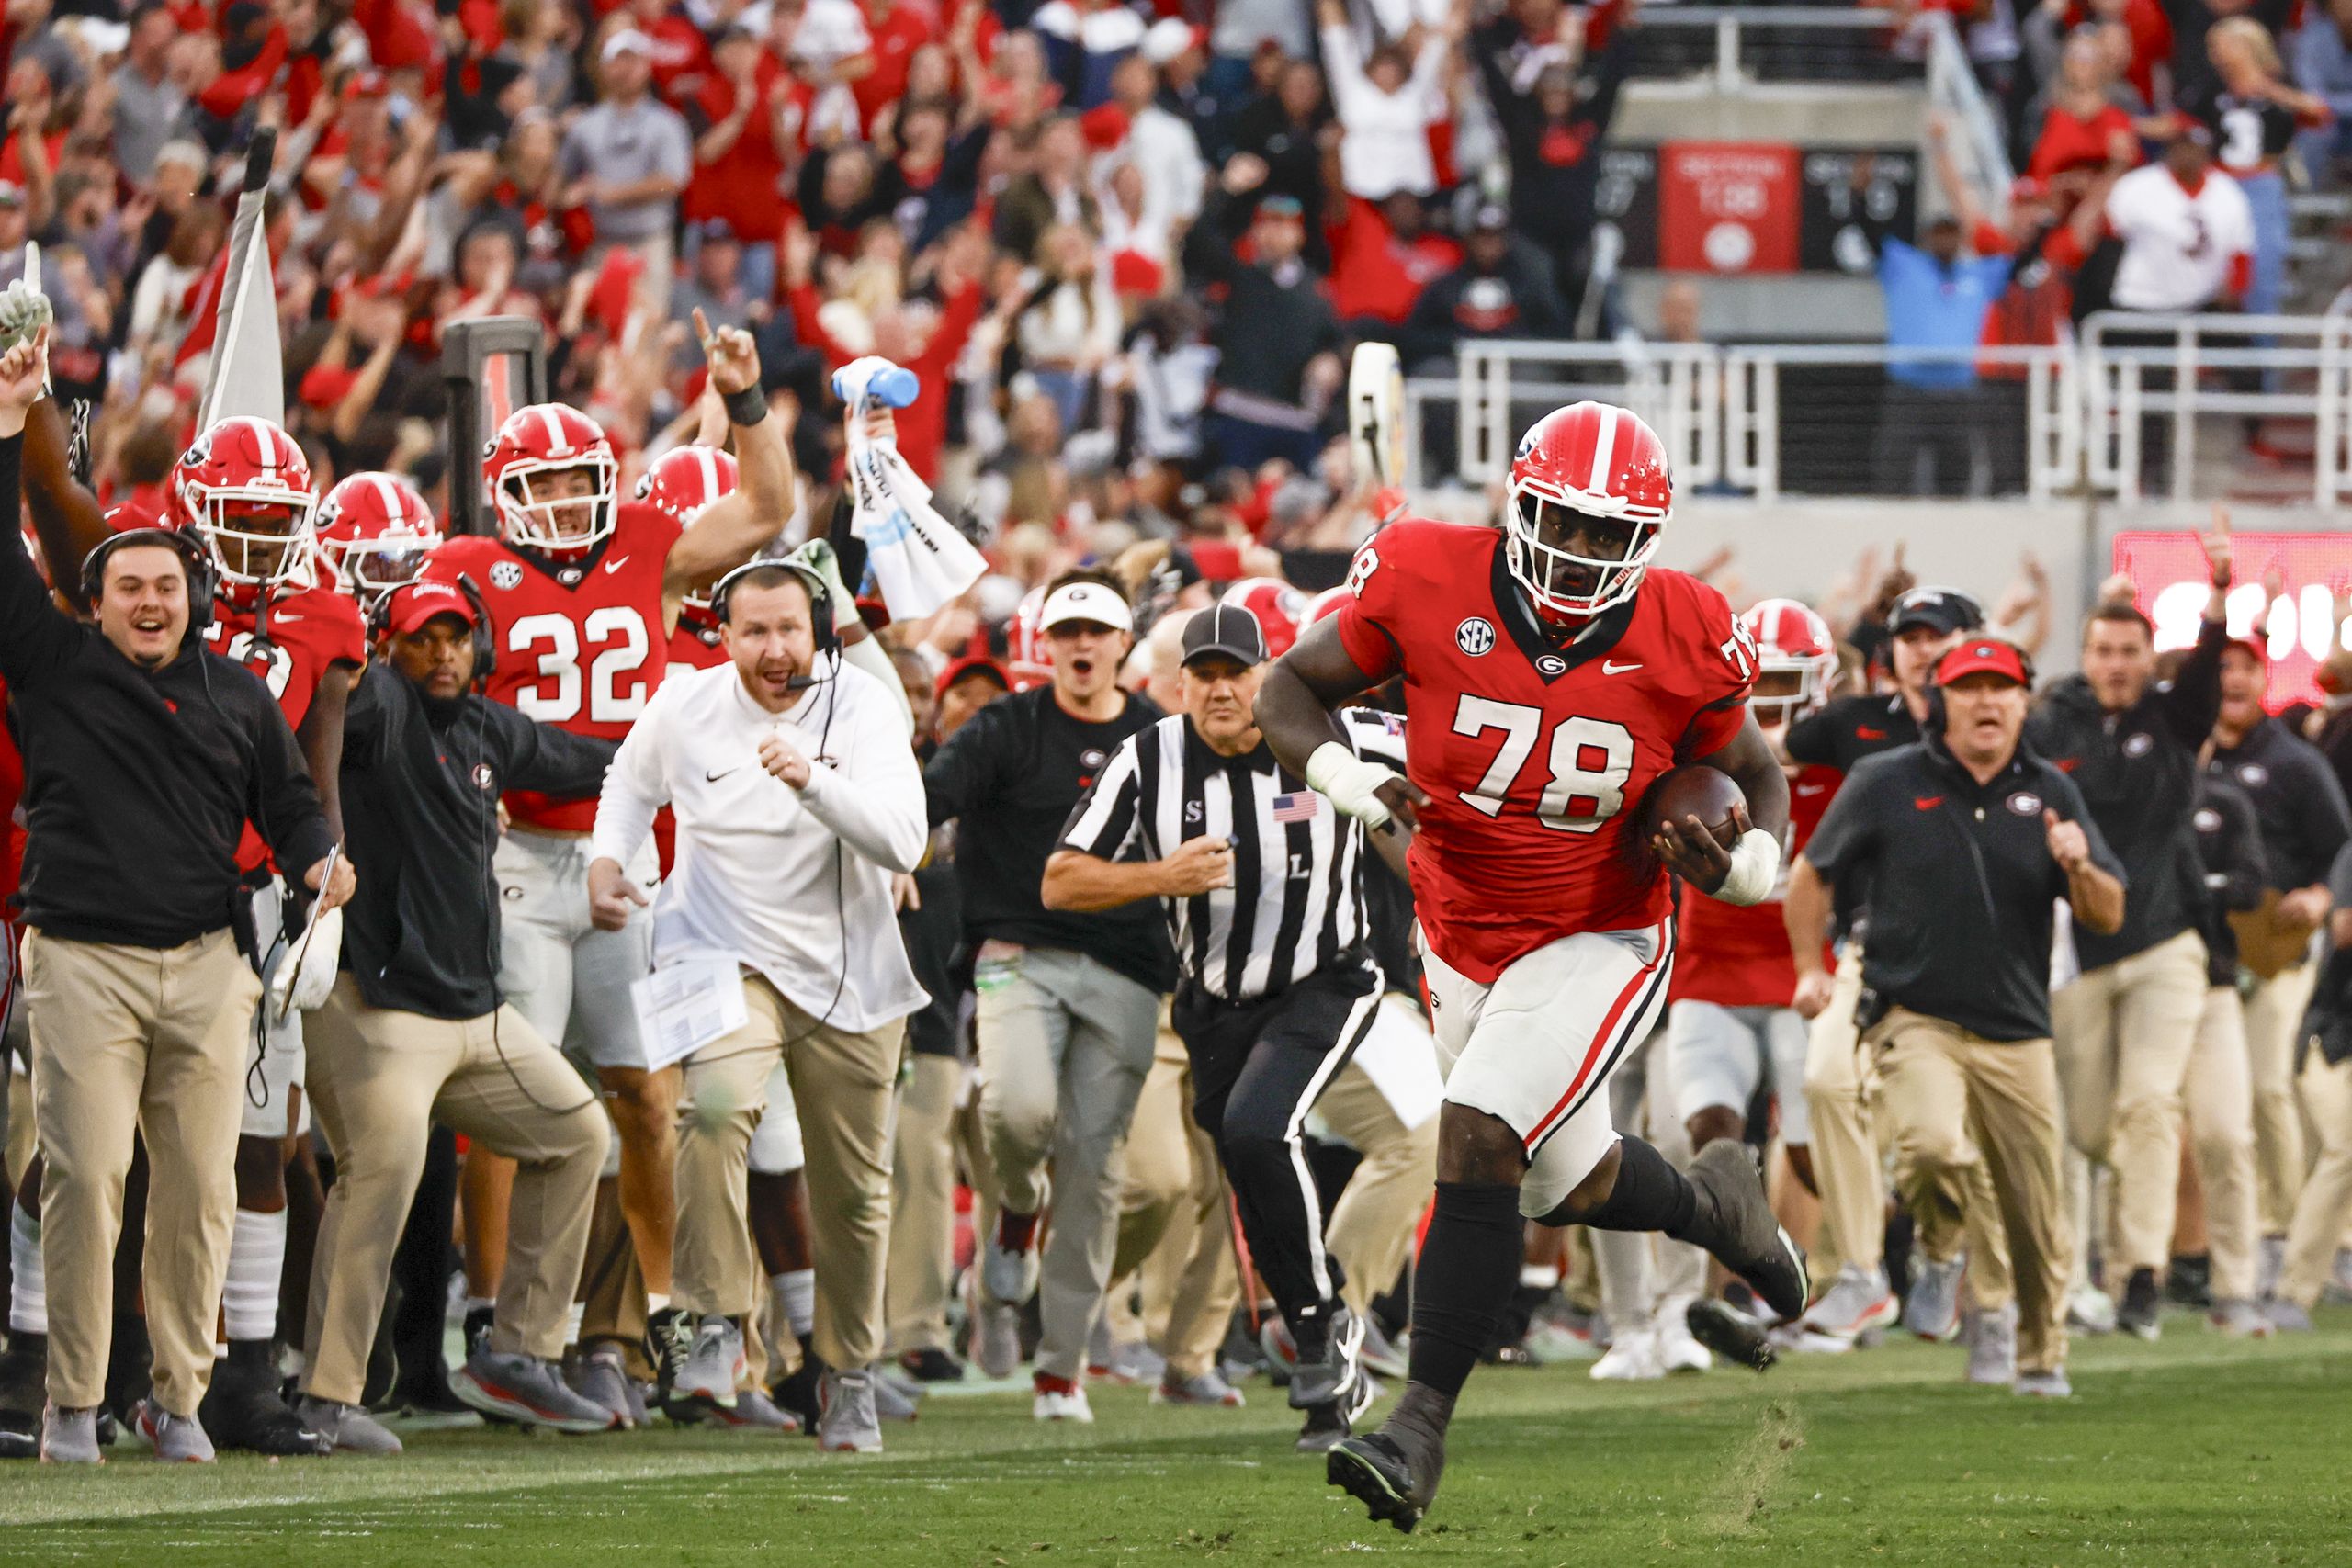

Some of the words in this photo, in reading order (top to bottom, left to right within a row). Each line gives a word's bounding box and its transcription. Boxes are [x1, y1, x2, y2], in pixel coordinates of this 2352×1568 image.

[2220, 107, 2266, 169] 3
[1459, 619, 1494, 653] SEC
[508, 605, 650, 723] 32
[1451, 693, 1634, 833] 78
[1184, 800, 1204, 823] S
[1288, 854, 1310, 879] L
